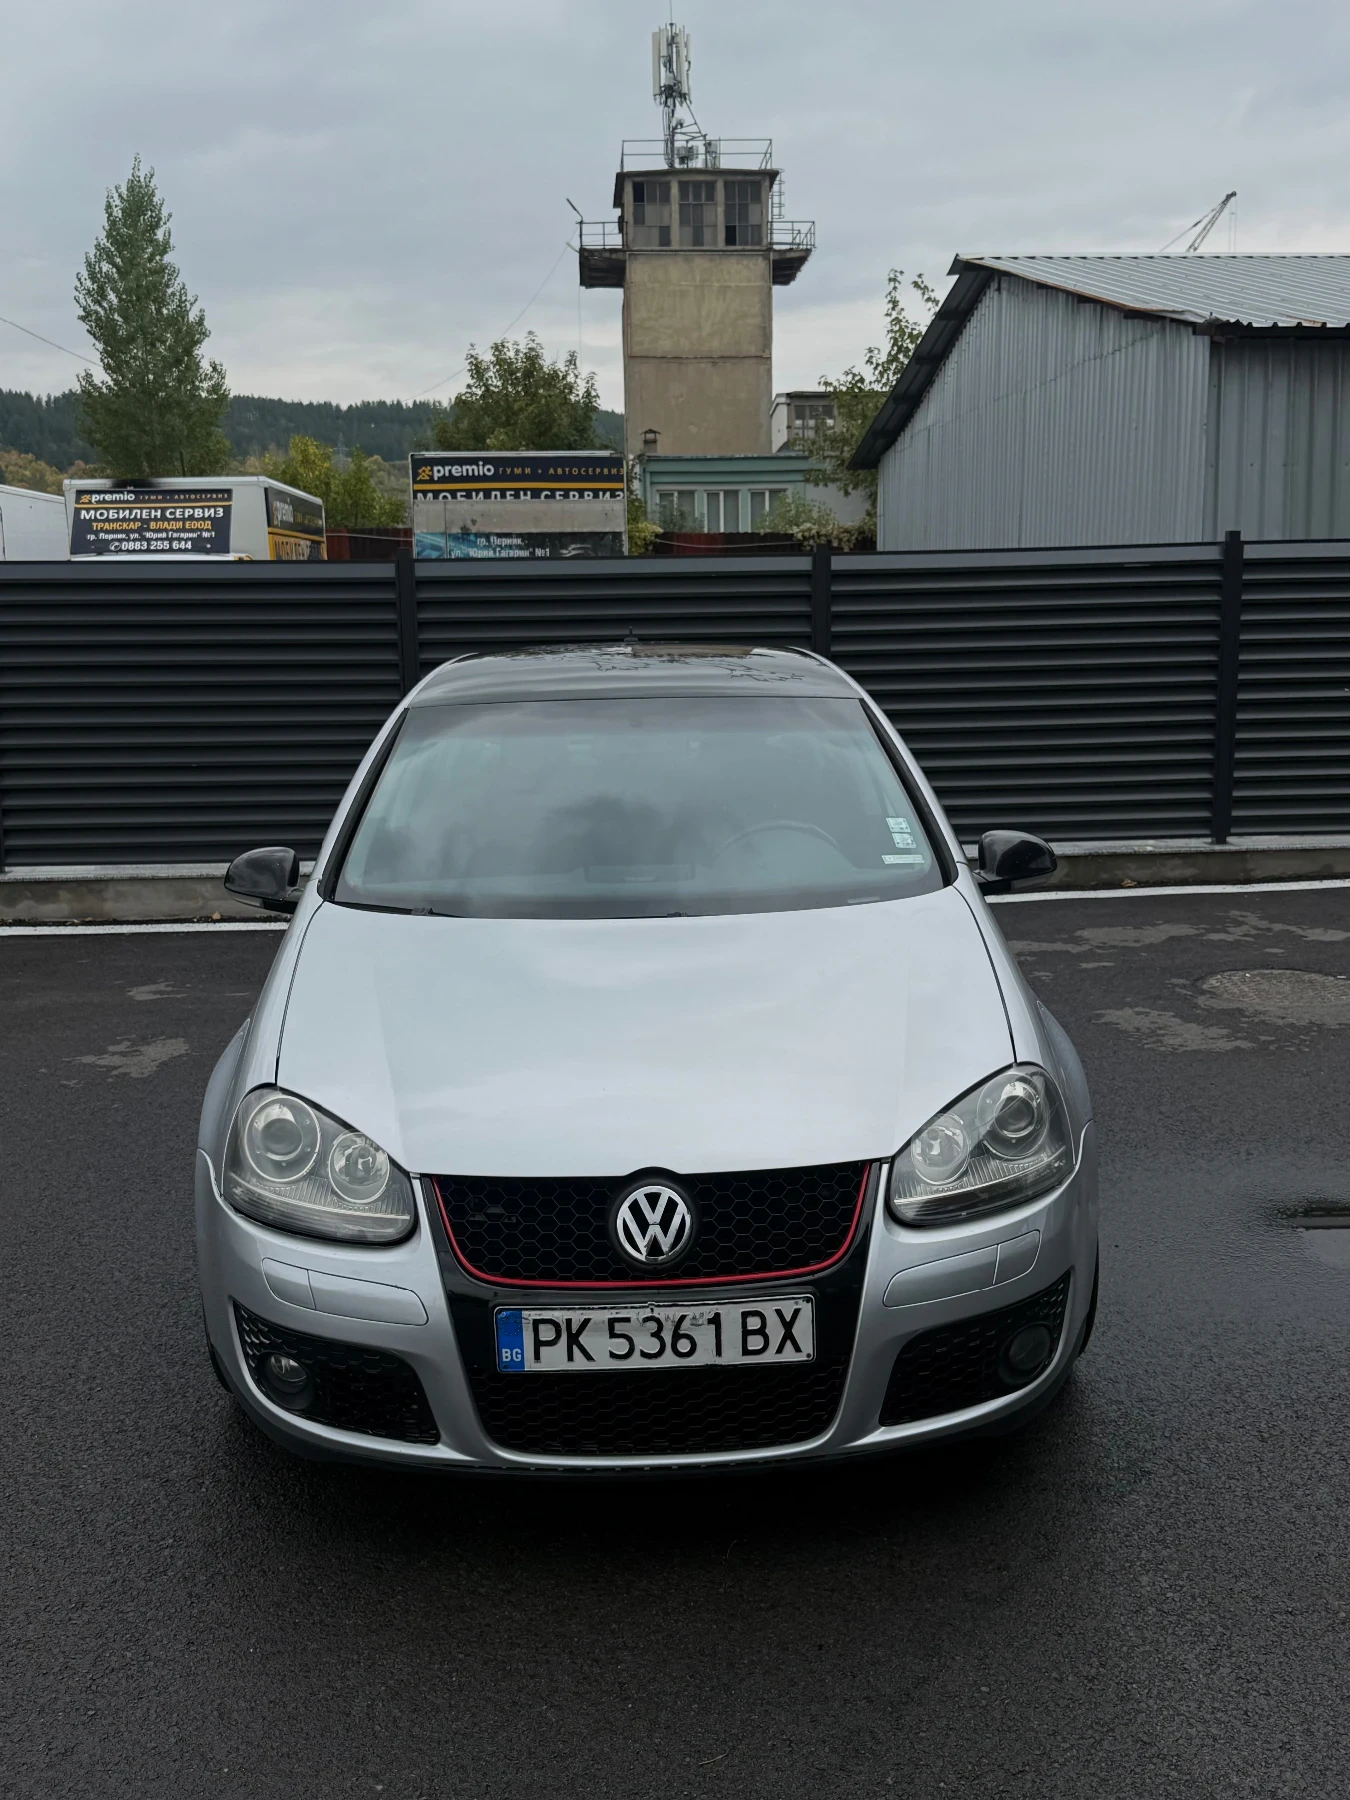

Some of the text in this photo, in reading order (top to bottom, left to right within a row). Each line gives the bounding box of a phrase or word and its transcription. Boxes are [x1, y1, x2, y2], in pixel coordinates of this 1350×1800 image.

[433, 461, 495, 481] premio
[499, 467, 531, 475] ГУМИ
[548, 467, 624, 475] АВТОСЕРВИЗ
[91, 491, 135, 504] premio
[80, 507, 224, 520] МОБИЛЕН СЕРВИЗ
[92, 522, 142, 531] ТРАНСКАР
[149, 521, 183, 530] ВЛАДИ
[185, 521, 212, 530] ЕООД
[86, 533, 97, 541] гр.
[99, 532, 128, 540] Перник,
[129, 532, 141, 540] ул.
[476, 537, 489, 547] гр.
[121, 540, 192, 550] 0883 255 644
[535, 547, 550, 557] №1
[617, 1186, 691, 1262] VW
[531, 1306, 803, 1364] PK 5361 BX
[501, 1348, 522, 1363] BG
